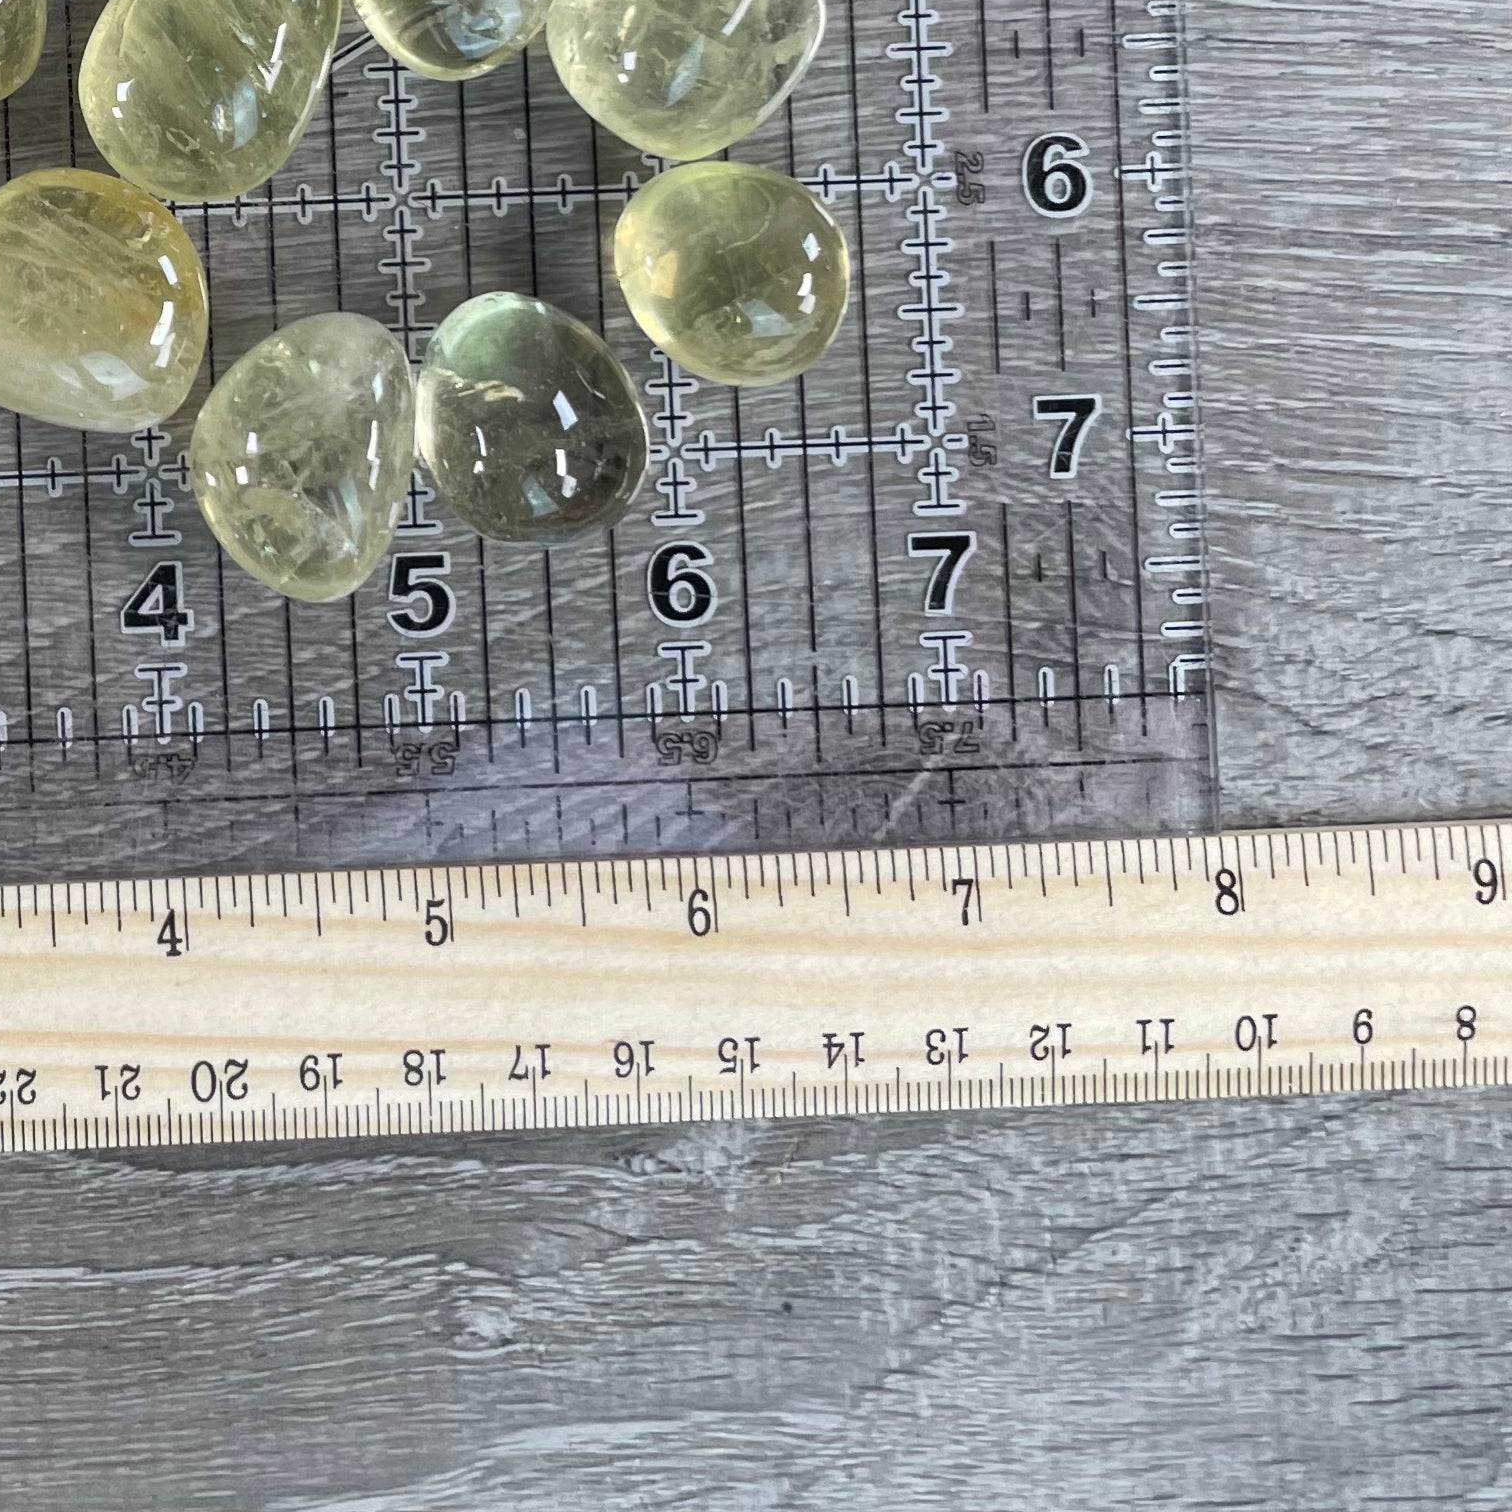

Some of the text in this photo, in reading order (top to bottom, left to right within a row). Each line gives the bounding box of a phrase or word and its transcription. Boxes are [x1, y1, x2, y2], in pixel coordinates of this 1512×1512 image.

[1023, 132, 1092, 218] 6
[1032, 393, 1104, 479] 7
[647, 541, 718, 628] 6
[908, 531, 976, 615] 7
[121, 561, 194, 647] 4
[387, 551, 457, 638] 5
[952, 878, 973, 925] 7
[1216, 868, 1239, 915] 8
[1474, 859, 1498, 905] 9
[158, 909, 183, 956] 4
[425, 899, 448, 946] 5
[688, 889, 711, 937] 6
[1030, 1023, 1072, 1061] 12
[1137, 1019, 1175, 1054] 11
[1235, 1014, 1278, 1052] 10
[1353, 1008, 1373, 1044] 9
[1456, 1005, 1477, 1041] 8
[509, 1044, 551, 1081] 17
[614, 1040, 655, 1078] 16
[718, 1037, 761, 1074] 15
[823, 1032, 865, 1069] 14
[925, 1027, 969, 1065] 13
[95, 1064, 141, 1101] 21
[191, 1058, 248, 1102] 20
[299, 1053, 343, 1090] 19
[404, 1049, 446, 1086] 18
